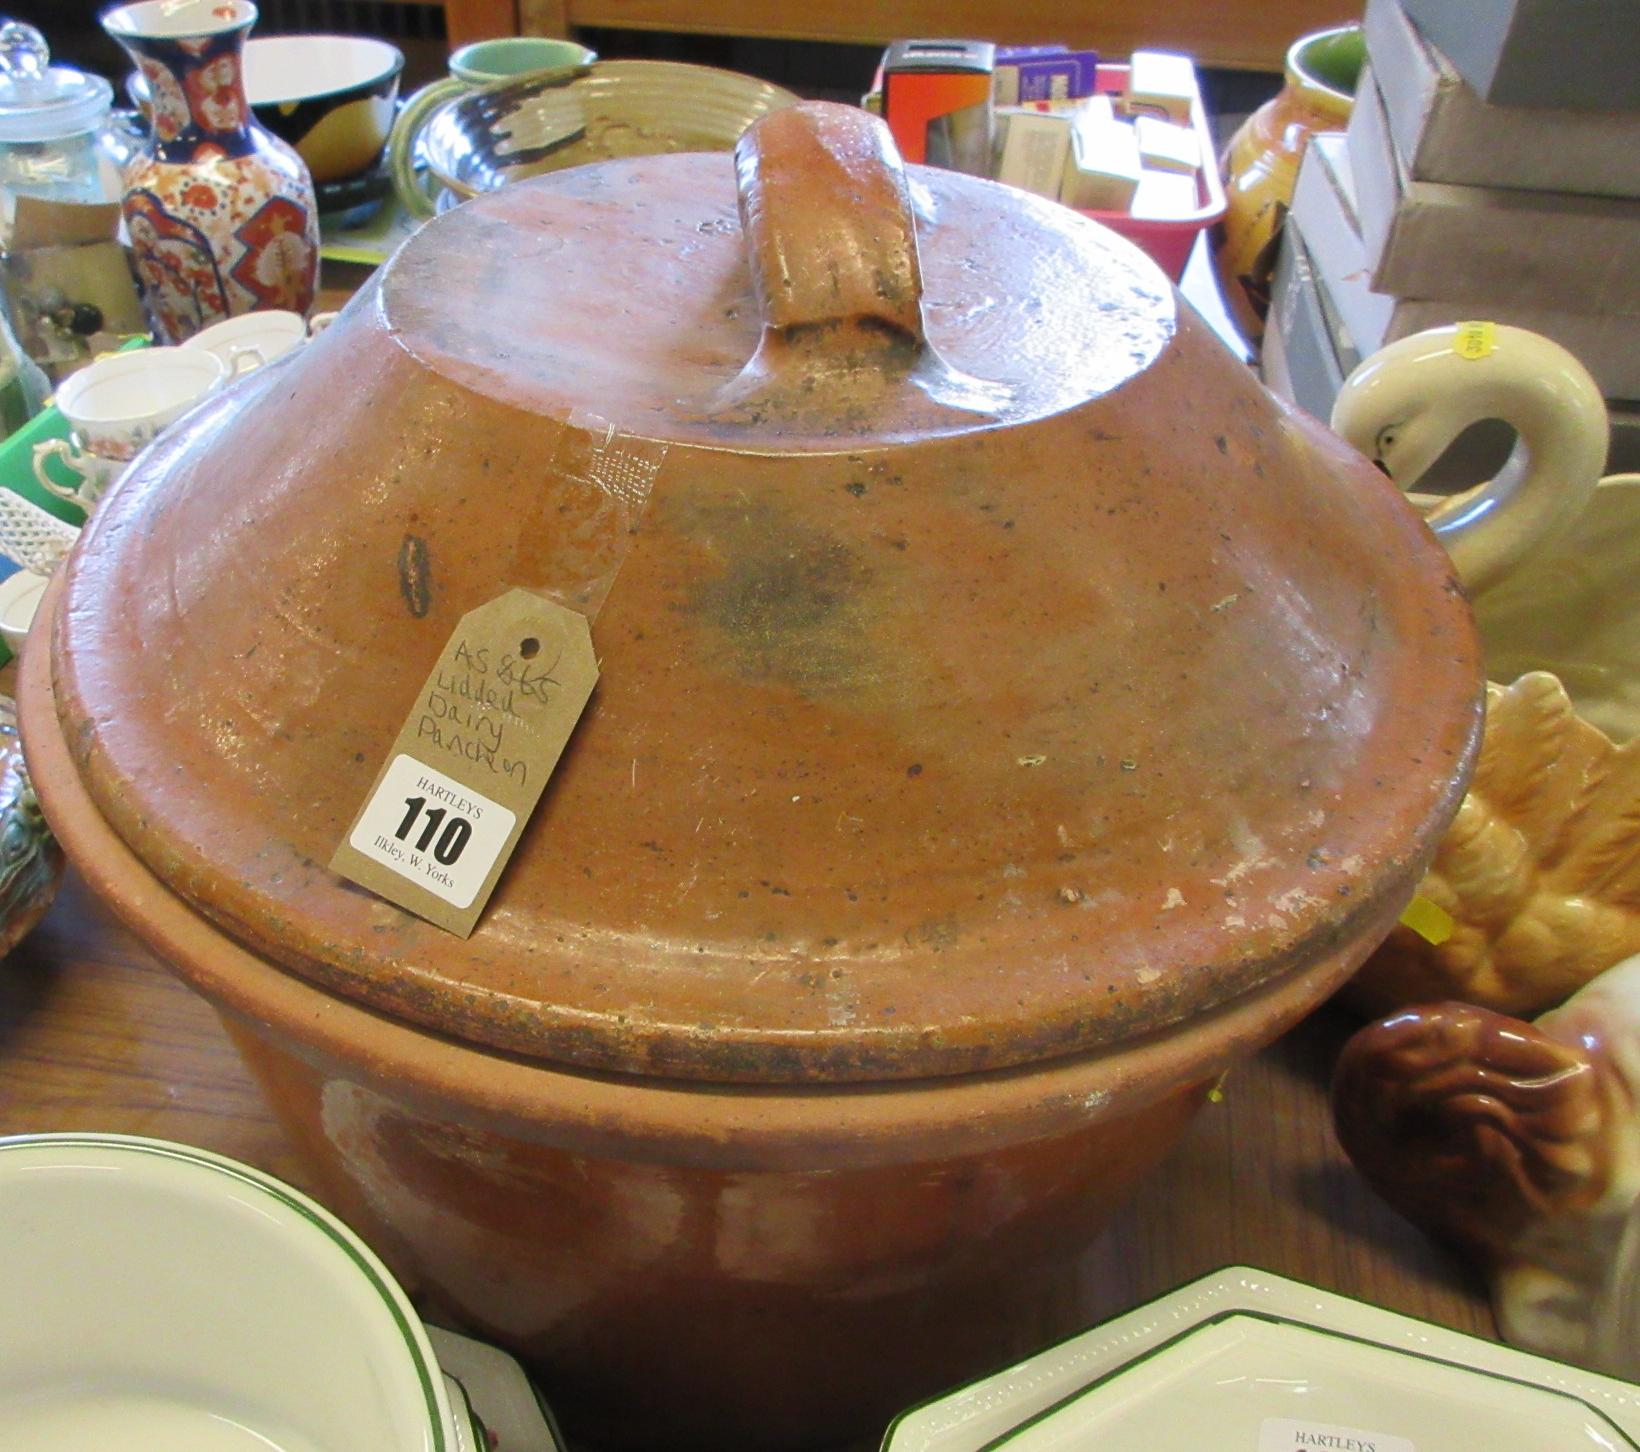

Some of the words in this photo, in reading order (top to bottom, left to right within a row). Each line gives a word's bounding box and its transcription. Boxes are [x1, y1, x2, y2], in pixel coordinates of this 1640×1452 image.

[436, 671, 521, 718] Lidded
[428, 690, 504, 754] Dairy
[415, 776, 485, 820] HARTLEYS
[394, 796, 473, 867] 110
[425, 862, 456, 889] Yorks
[1295, 1430, 1376, 1452] HARTLEYS
